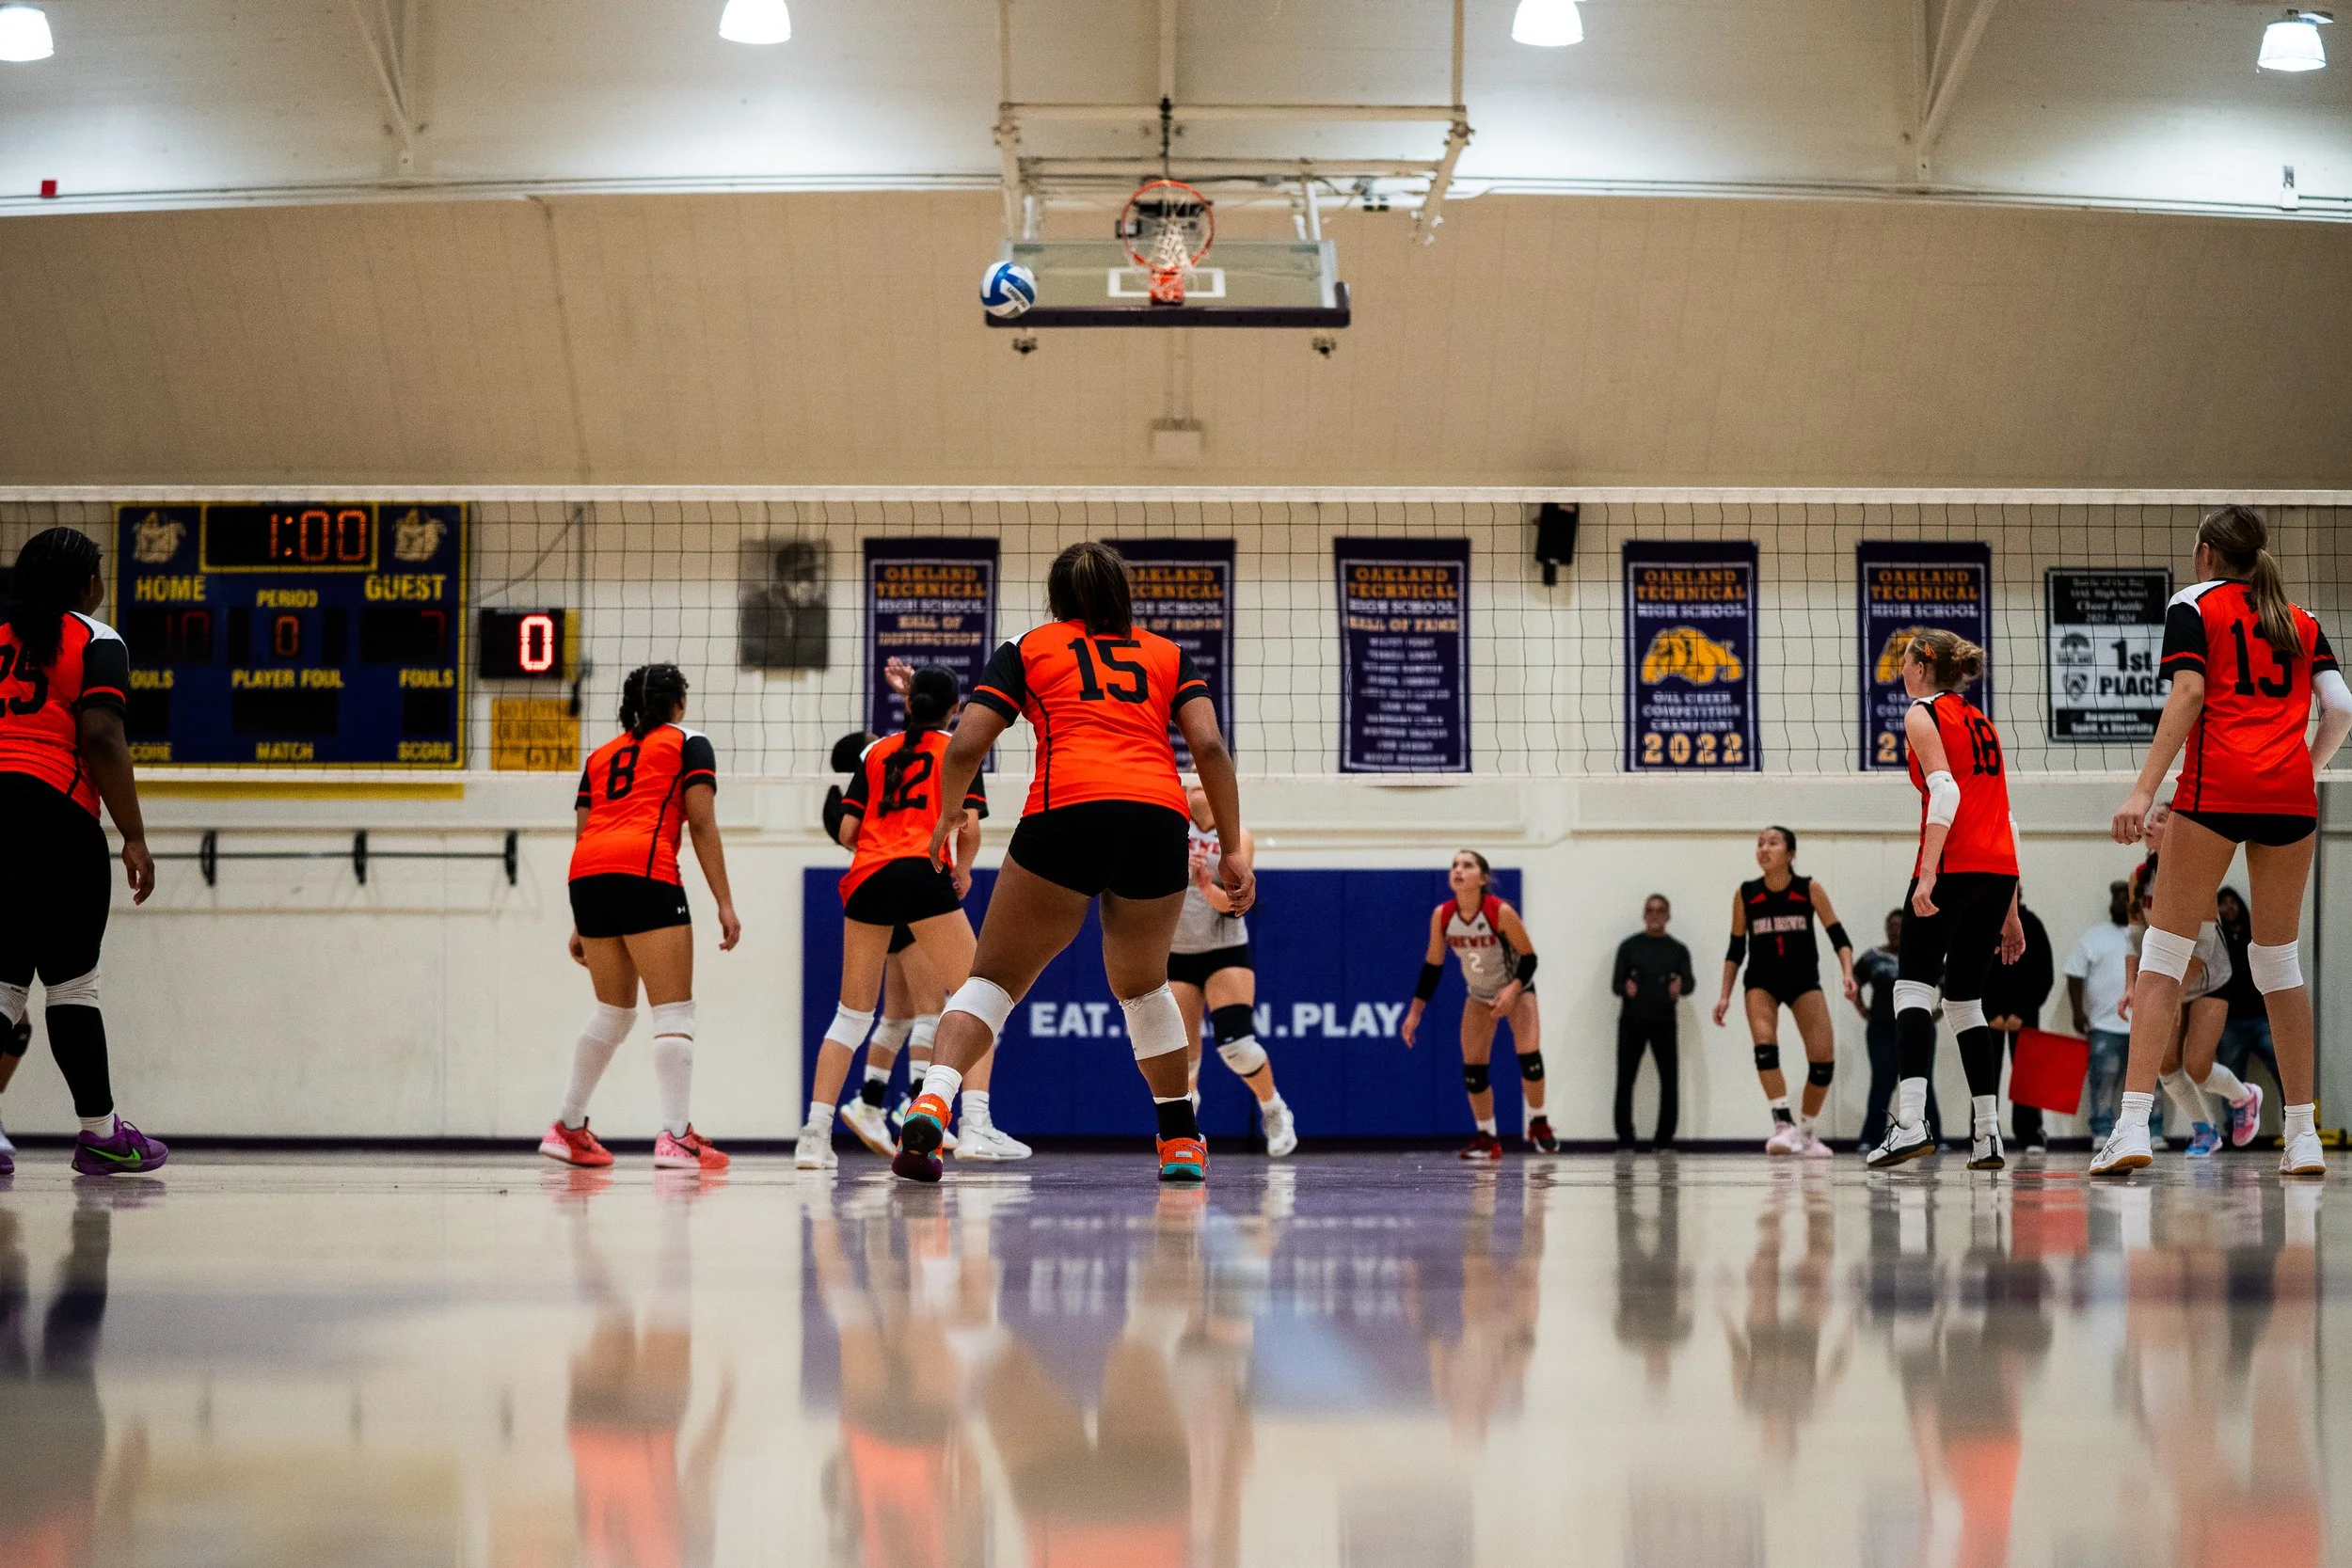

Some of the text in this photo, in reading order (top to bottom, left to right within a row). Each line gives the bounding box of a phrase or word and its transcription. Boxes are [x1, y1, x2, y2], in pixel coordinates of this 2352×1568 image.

[269, 509, 368, 562] 1:00
[883, 566, 977, 581] OAKLAND
[1355, 567, 1449, 582] OAKLAND
[1644, 569, 1737, 584] OAKLAND
[1878, 569, 1970, 584] OAKLAND
[135, 575, 208, 603] HOME
[364, 574, 448, 602] GUEST
[876, 581, 987, 597] TECHNICAL
[1130, 583, 1225, 599] CHNICAL
[1347, 581, 1458, 599] TECHNICAL
[1636, 584, 1747, 601] TECHNICAL
[1870, 584, 1980, 601] TECHNICAL
[256, 589, 319, 609] PERIOD
[1637, 602, 1747, 618] HIGH SCHOOL
[1871, 603, 1979, 618] HIGH SCHOOL
[275, 615, 300, 657] 0
[518, 613, 554, 673] 0
[2110, 640, 2153, 673] 1st
[2230, 618, 2294, 699] 13
[129, 669, 175, 689] OULS
[231, 669, 345, 689] PLAYER FOUL
[398, 669, 455, 689] FOULS
[1067, 637, 1151, 705] 15
[2099, 675, 2167, 697] PLACE
[128, 741, 173, 762] CORE
[255, 741, 314, 762] MATCH
[397, 741, 453, 762] SCORE
[1642, 732, 1745, 765] 2022
[1963, 717, 2002, 777] 18
[606, 743, 641, 801] 8
[877, 750, 935, 818] 12
[1776, 934, 1785, 957] 1
[1467, 952, 1486, 974] 2
[1029, 1001, 1406, 1038] EAT.N.PLAY
